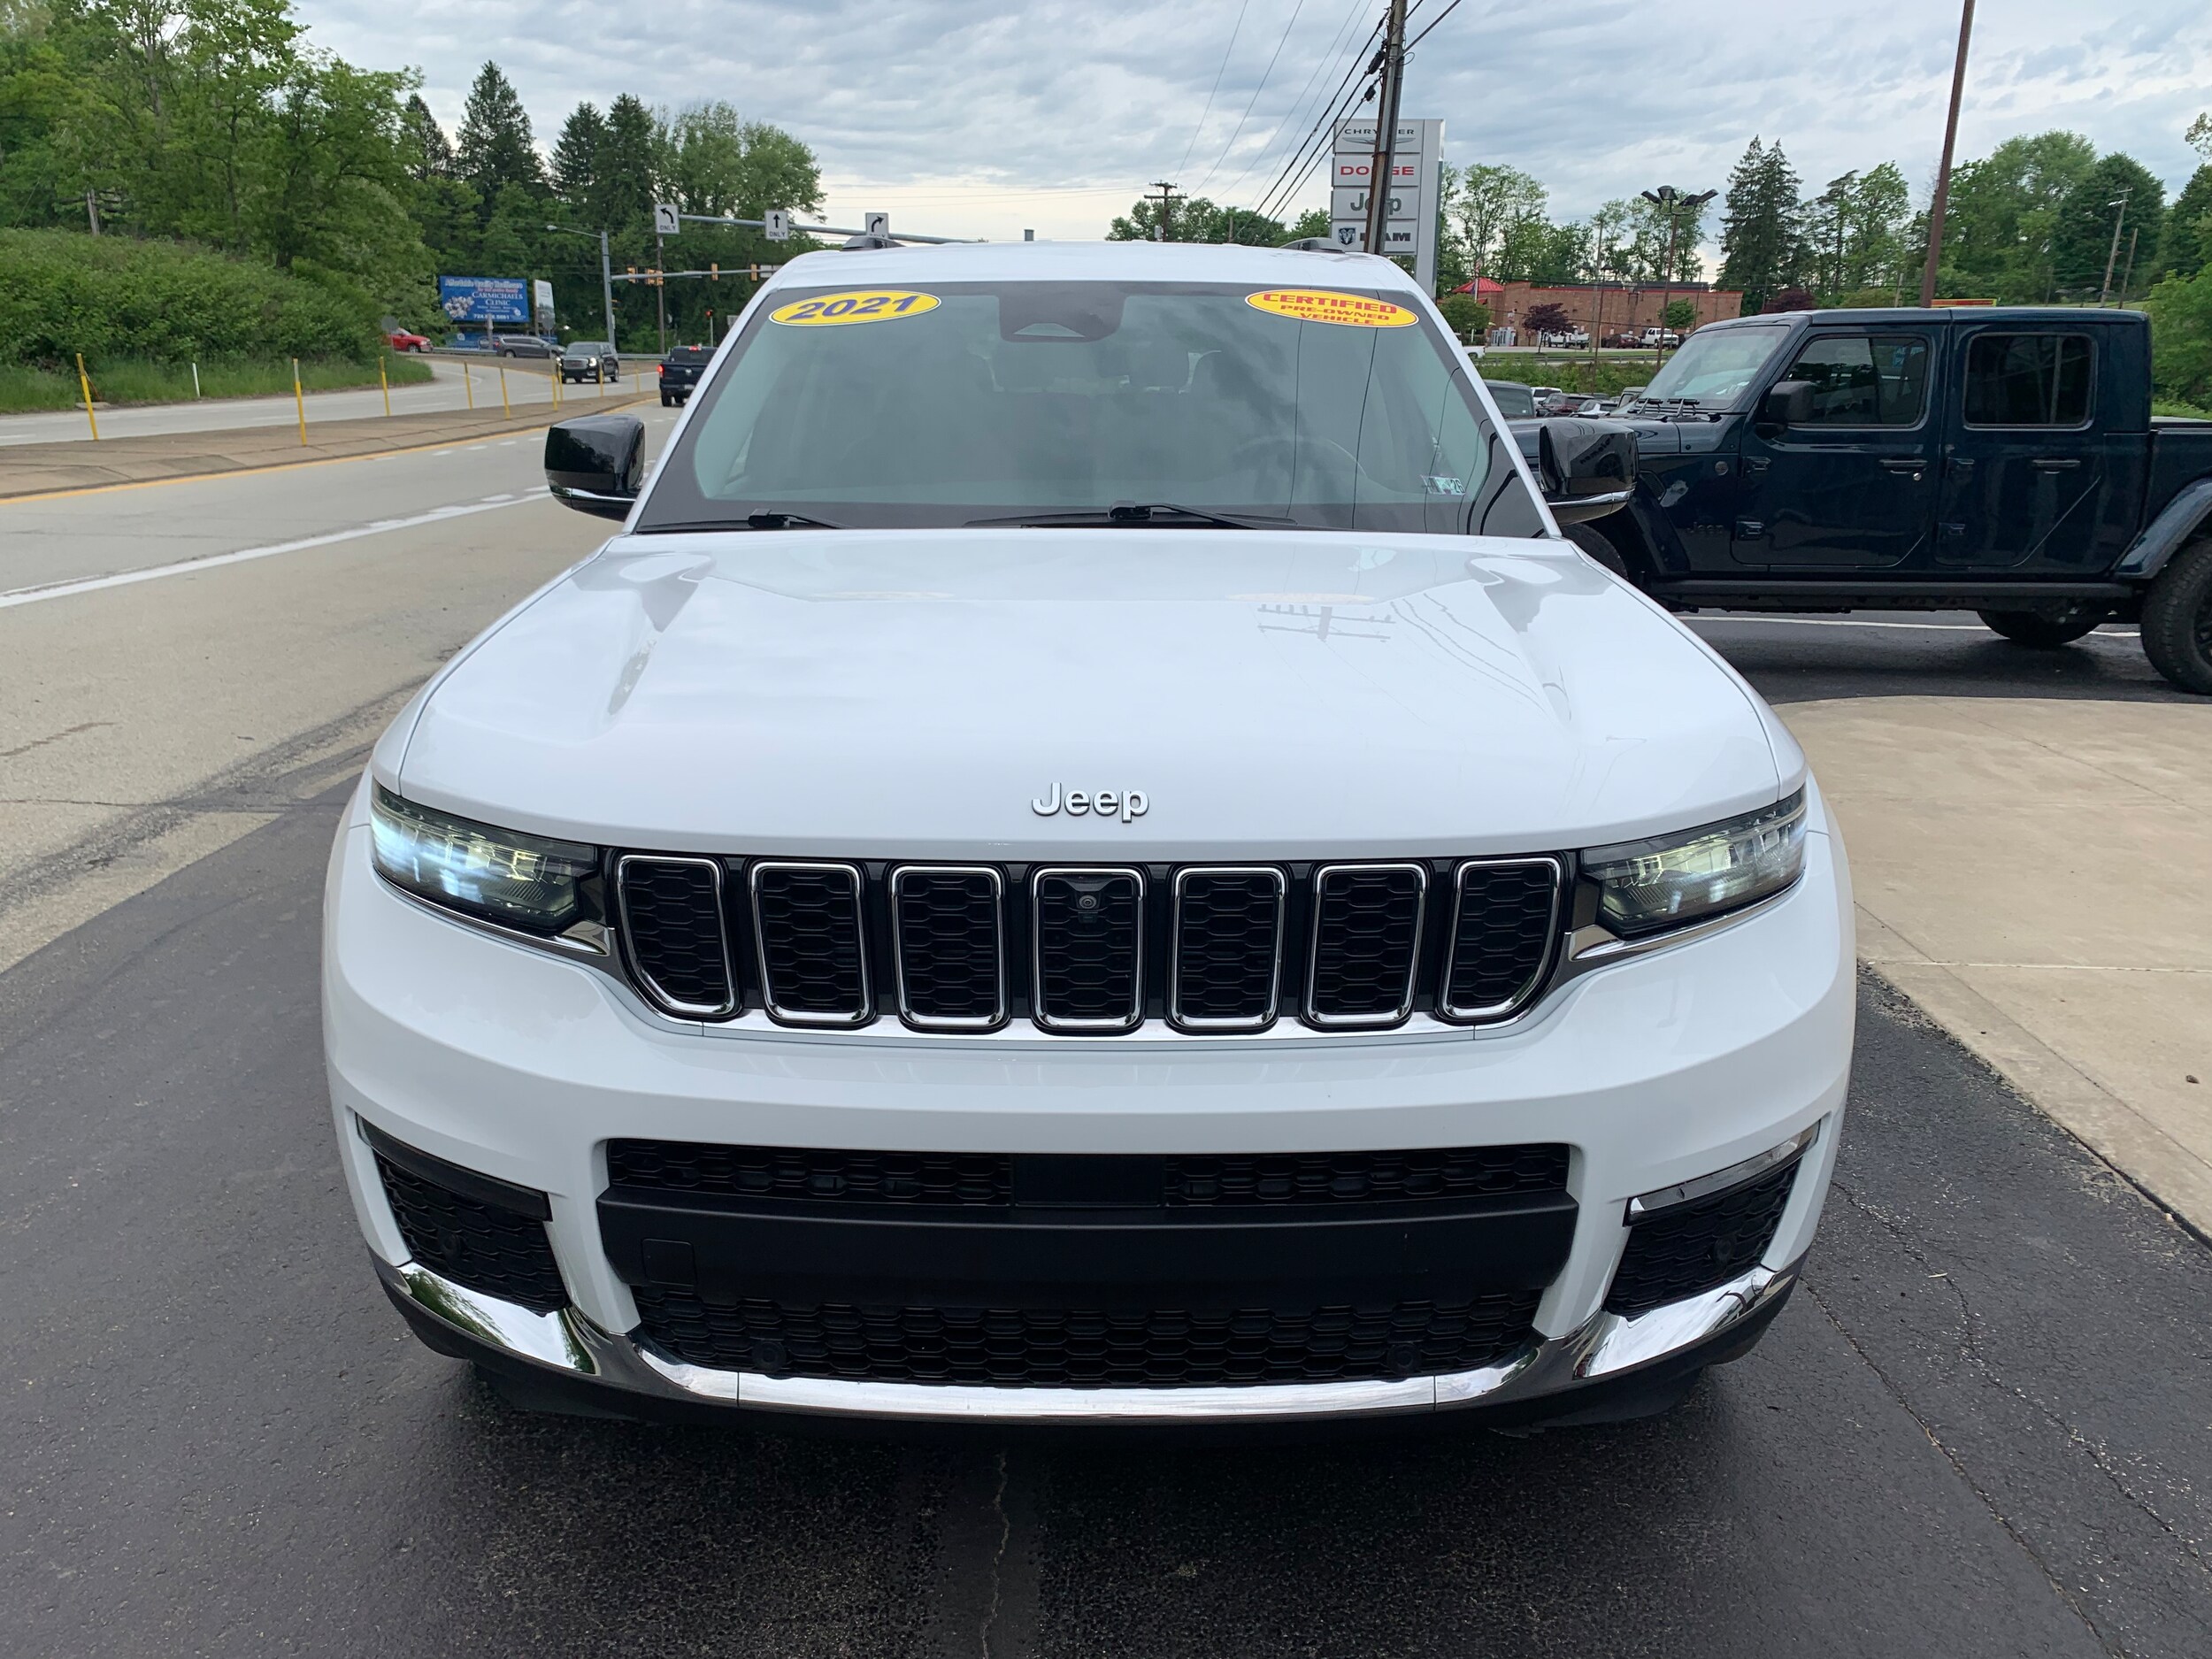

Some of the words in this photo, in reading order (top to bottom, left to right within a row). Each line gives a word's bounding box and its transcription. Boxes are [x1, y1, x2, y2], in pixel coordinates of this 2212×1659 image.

[785, 296, 920, 321] 2021
[1263, 294, 1397, 314] CERTIFIED
[1280, 304, 1390, 320] PRE-OWNED
[1032, 782, 1149, 823] Jeep
